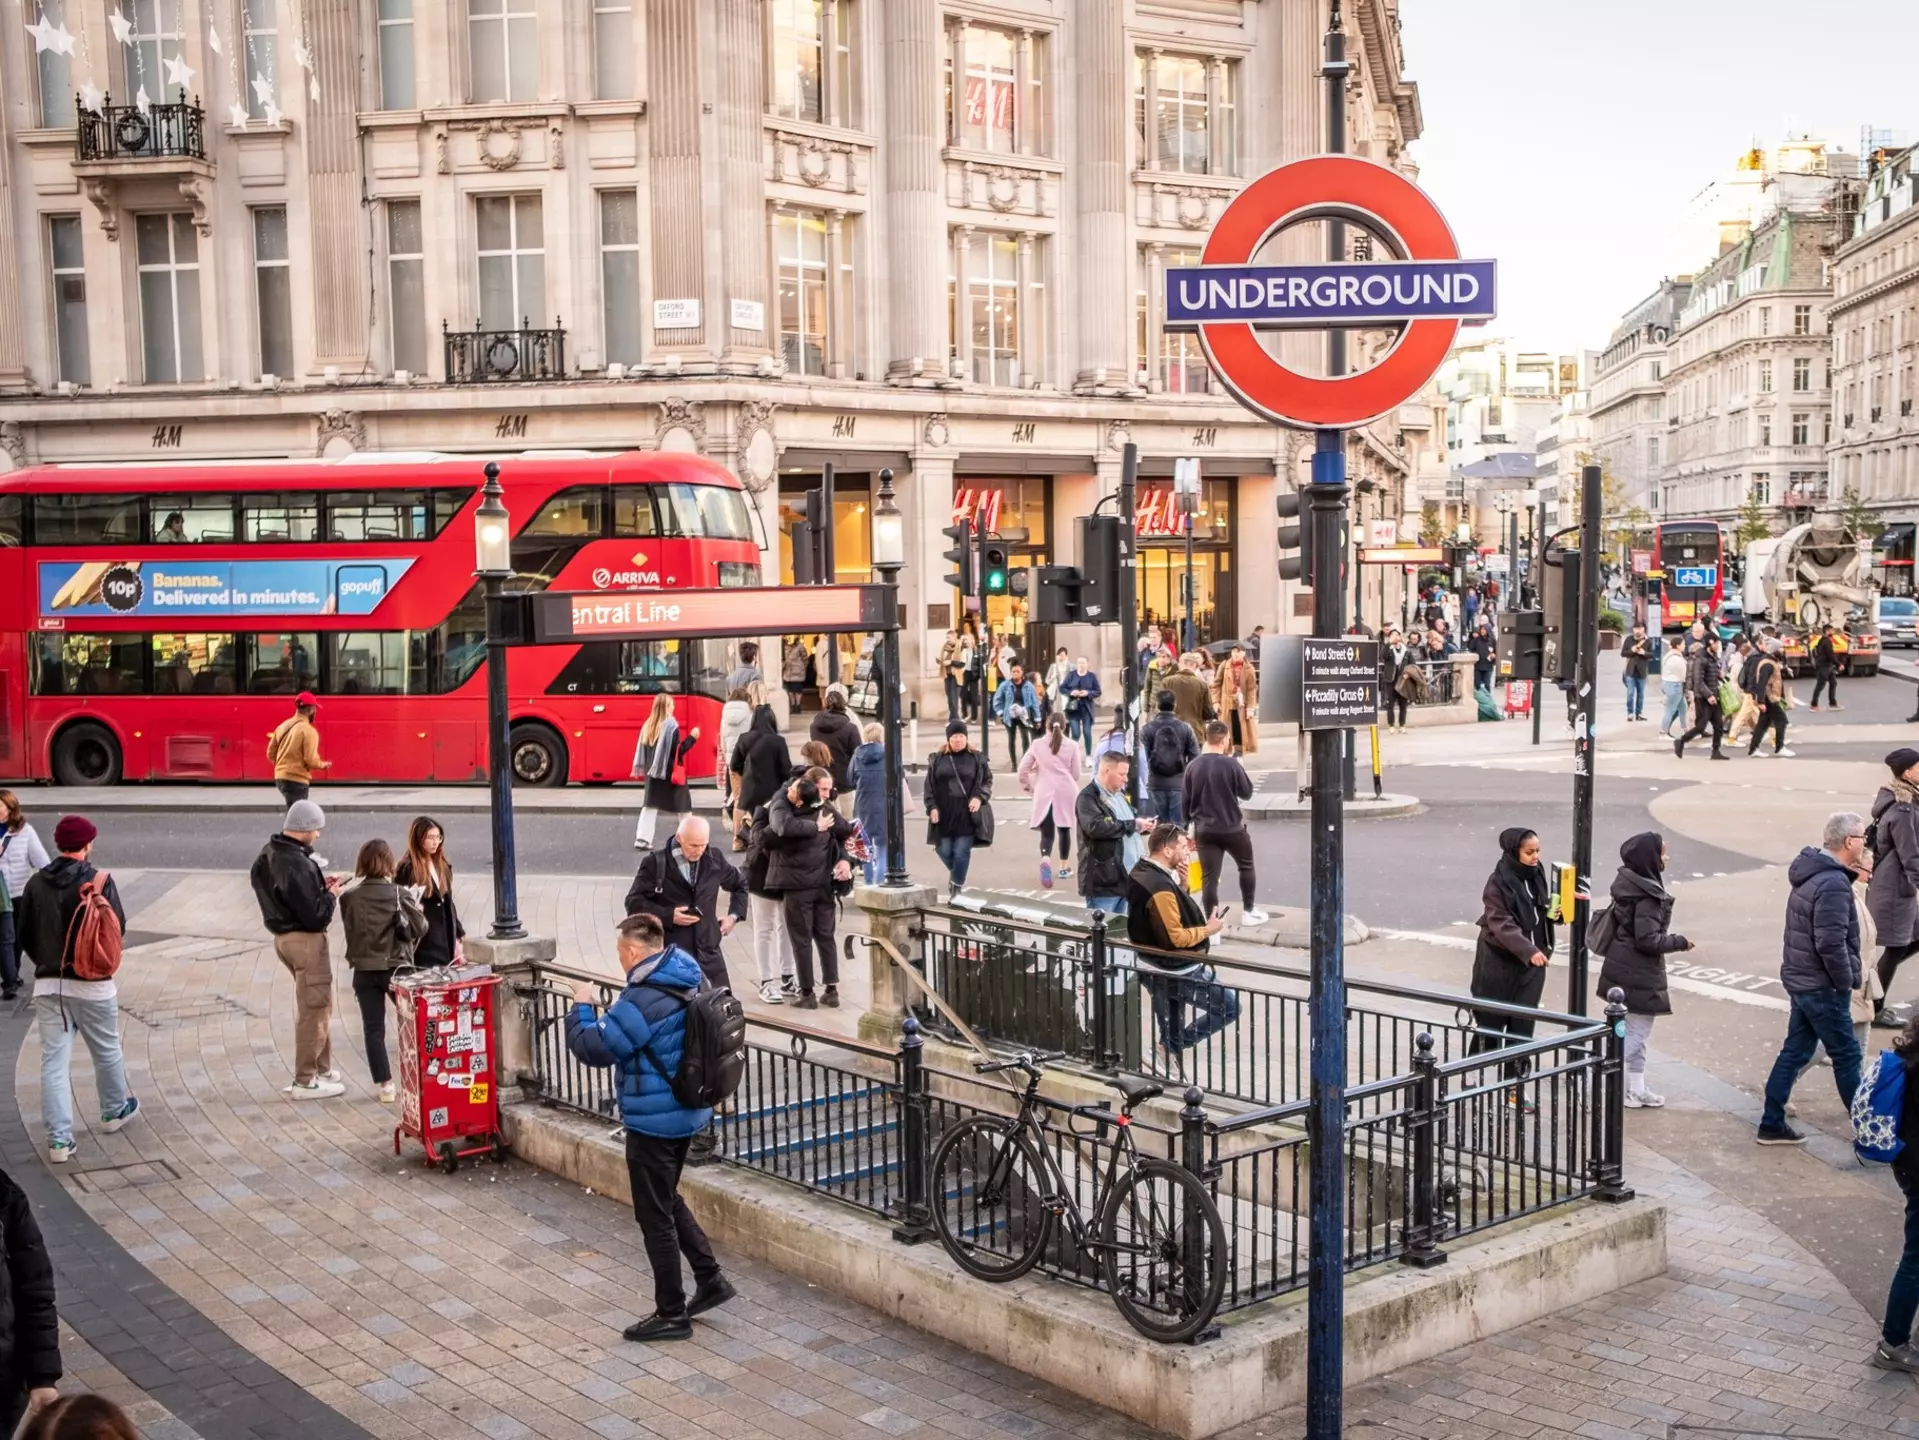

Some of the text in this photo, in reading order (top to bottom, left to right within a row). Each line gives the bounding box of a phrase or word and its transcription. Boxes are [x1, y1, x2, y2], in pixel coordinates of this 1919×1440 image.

[1179, 273, 1480, 310] UNDERGROUND
[495, 414, 528, 438] H&M
[832, 416, 856, 438] H&M
[1012, 423, 1036, 444] H&M
[152, 424, 182, 448] H&M
[1193, 428, 1217, 448] H&M
[341, 578, 383, 595] gopuff
[612, 572, 660, 584] ARRIVA
[153, 588, 320, 606] Delivered in minutes.
[573, 601, 680, 625] entral Line
[1311, 647, 1346, 660] Bond Street
[1316, 667, 1329, 675] minute
[1330, 667, 1339, 675] walk
[1340, 667, 1349, 676] along
[1350, 667, 1363, 675] Oxford
[1364, 666, 1375, 675] Street
[1311, 689, 1357, 704] Piccadilly Circus
[1316, 707, 1329, 715] minute
[1330, 706, 1339, 715] walk
[1340, 706, 1349, 716] along
[1364, 705, 1375, 713] Street
